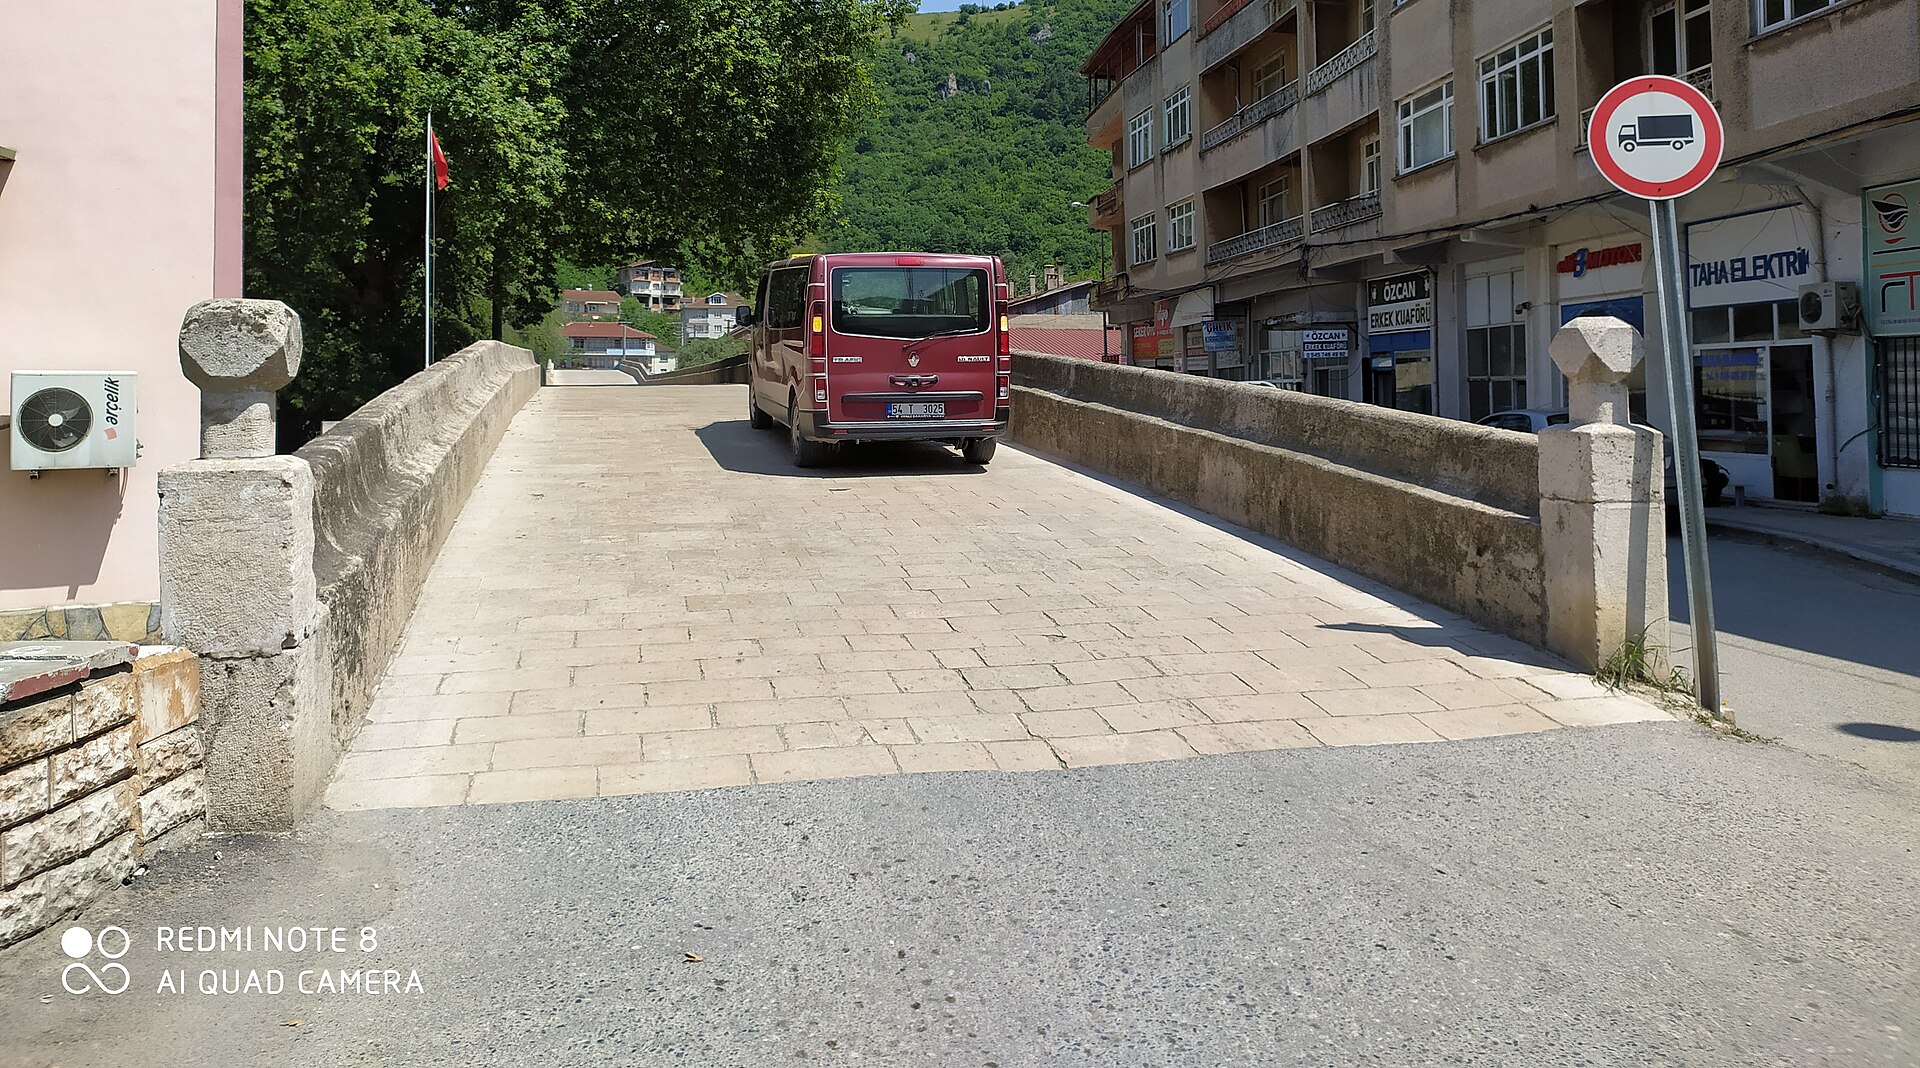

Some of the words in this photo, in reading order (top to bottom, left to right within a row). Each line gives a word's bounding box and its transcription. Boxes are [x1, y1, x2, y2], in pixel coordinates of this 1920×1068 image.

[1690, 260, 1729, 287] TAHA
[1383, 281, 1416, 301] ÖZCAN
[1371, 312, 1394, 329] ERKEK
[1395, 302, 1430, 326] KUAFÖRÜ
[1311, 331, 1340, 340] ÖZCAN
[104, 377, 121, 425] arçelik
[892, 404, 903, 414] 54
[908, 404, 914, 414] T
[923, 403, 943, 414] 3025
